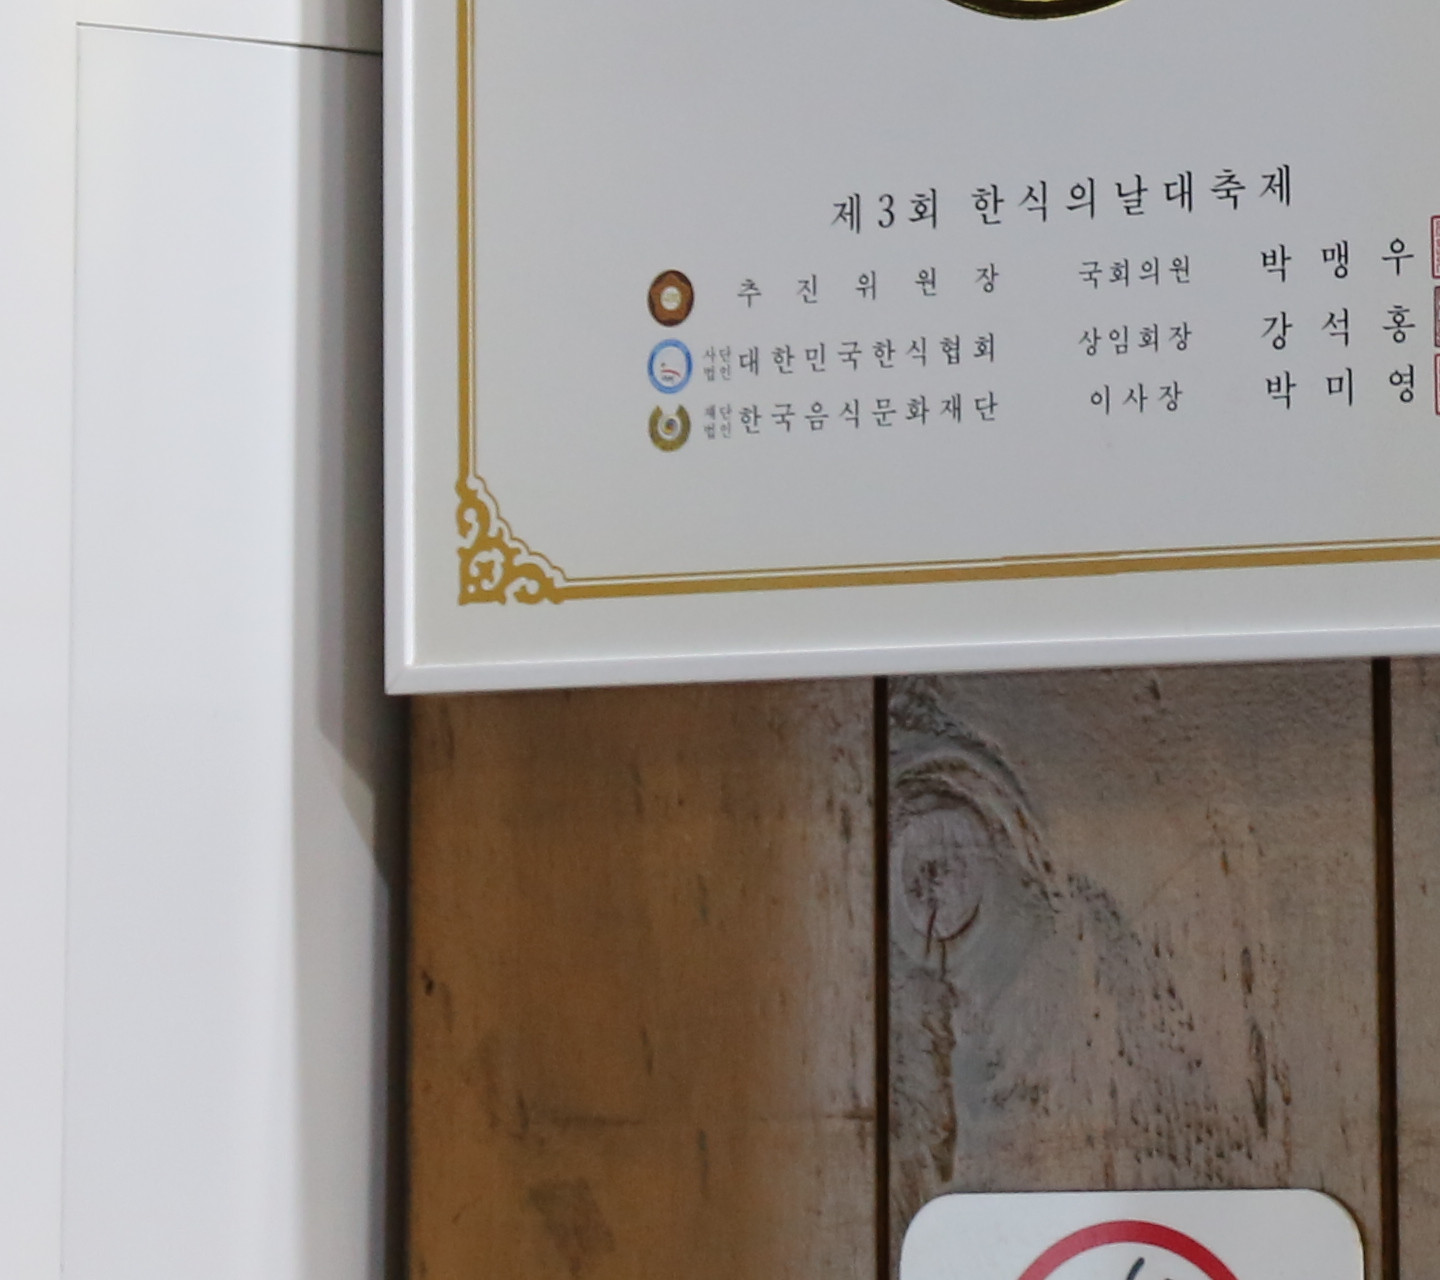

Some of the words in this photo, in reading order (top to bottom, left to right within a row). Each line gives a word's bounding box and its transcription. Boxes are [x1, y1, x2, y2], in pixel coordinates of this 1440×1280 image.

[1078, 254, 1190, 290] 국회의원
[738, 332, 998, 378] 대한민국한식협회
[1079, 321, 1193, 357] 상임회장
[738, 391, 999, 435] 한국음식문화재단
[1090, 380, 1183, 416] 이사장
